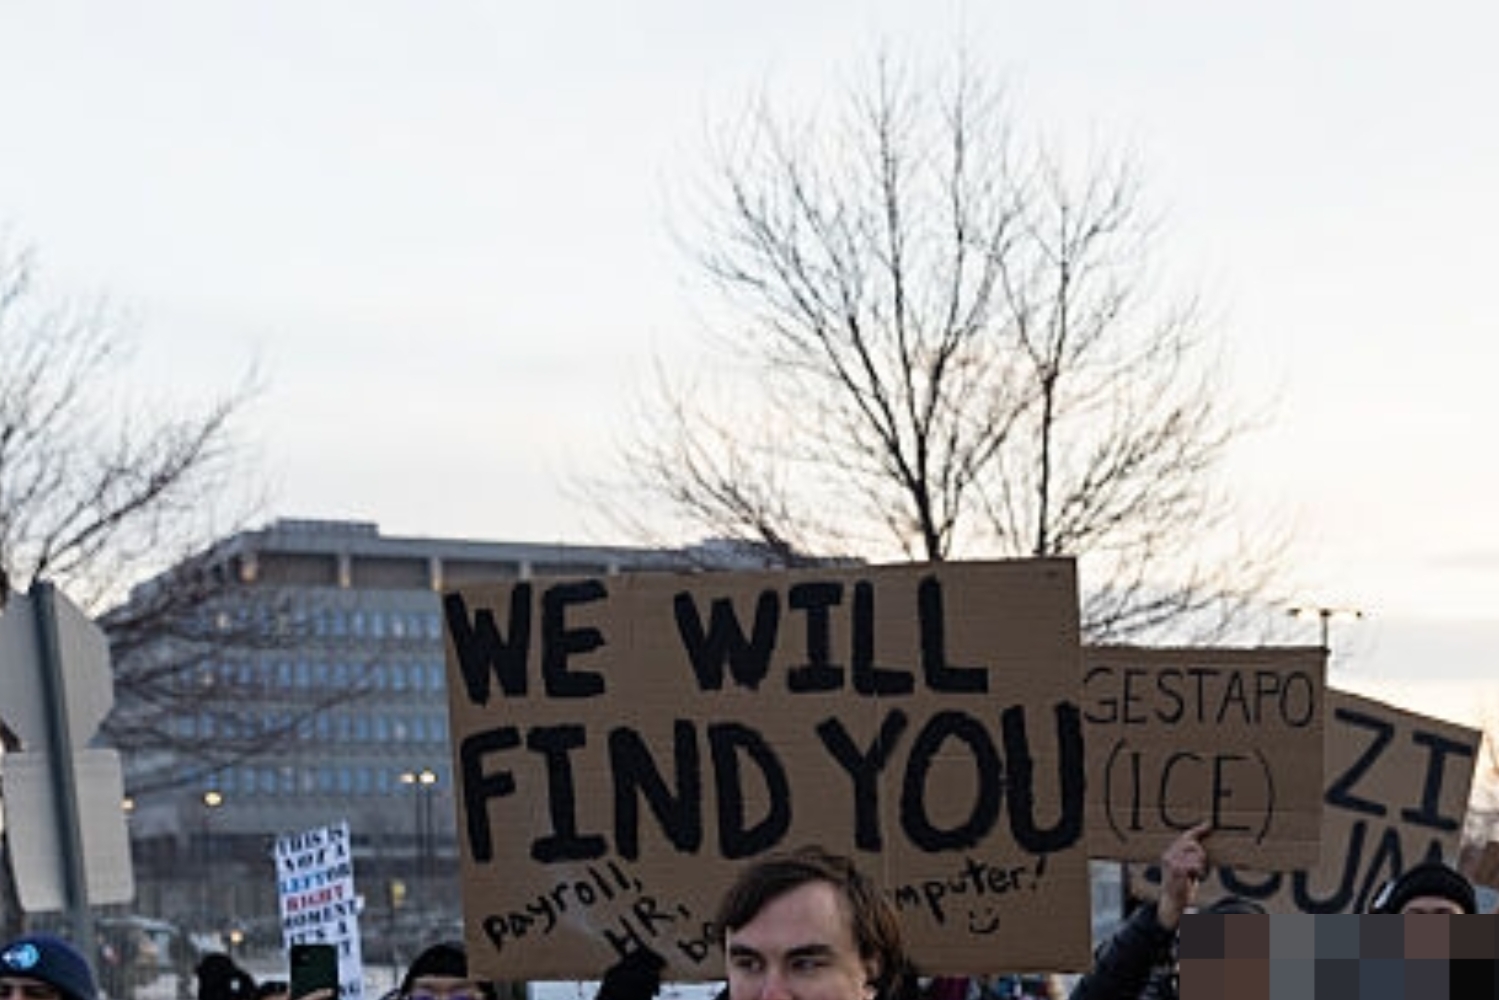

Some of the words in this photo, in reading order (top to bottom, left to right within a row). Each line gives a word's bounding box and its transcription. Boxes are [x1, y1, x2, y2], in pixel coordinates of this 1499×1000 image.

[443, 580, 608, 707] WE
[674, 575, 989, 697] WILL
[1083, 666, 1315, 727] GESTAPO
[460, 722, 792, 864] FIND
[815, 700, 1087, 856] YOU
[1103, 737, 1276, 845] (ICE)
[1324, 708, 1474, 832] ZI
[483, 860, 642, 951] payroll,
[896, 854, 1047, 926] mputer!
